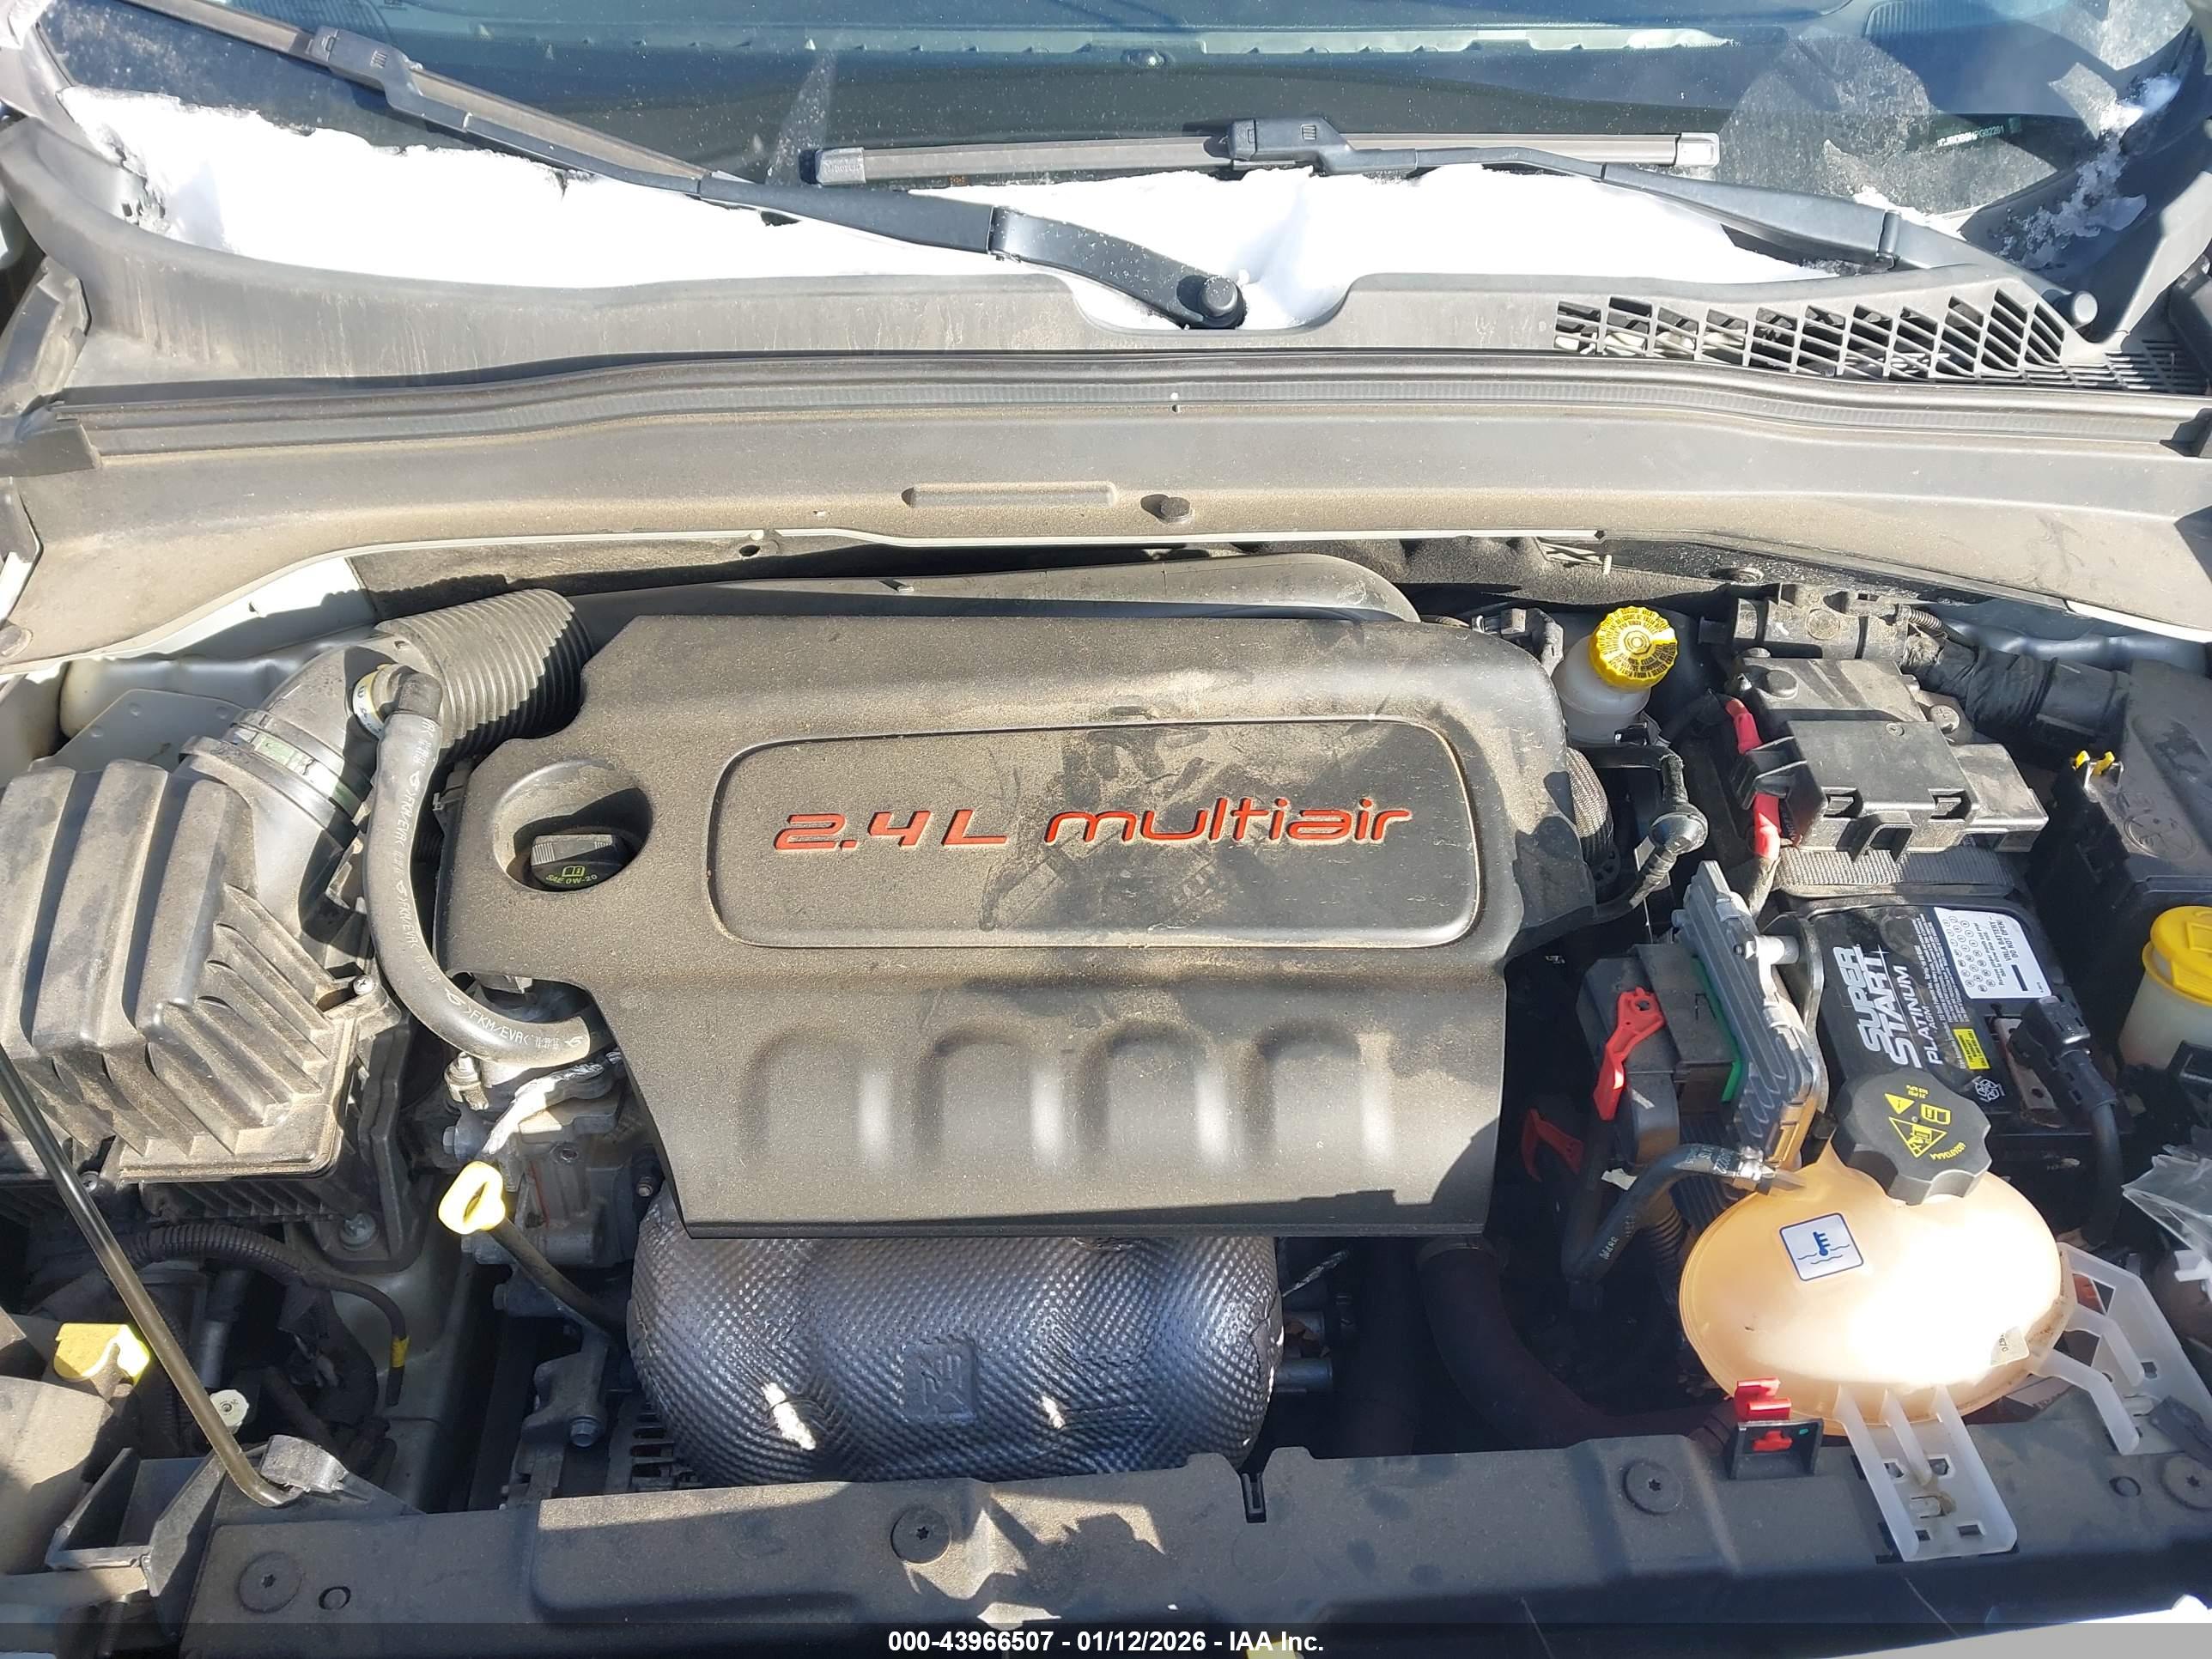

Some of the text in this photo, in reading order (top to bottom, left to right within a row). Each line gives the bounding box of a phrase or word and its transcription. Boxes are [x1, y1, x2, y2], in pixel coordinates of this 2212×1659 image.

[1044, 796, 1413, 846] multiair
[545, 873, 598, 884] SAE 0W-20
[1989, 921, 2005, 945] BATTERY
[1832, 945, 1882, 1053] SUPER
[1854, 945, 1923, 1068] START
[1892, 965, 1945, 1065] PLATINUM
[1922, 1005, 1938, 1032] AGM
